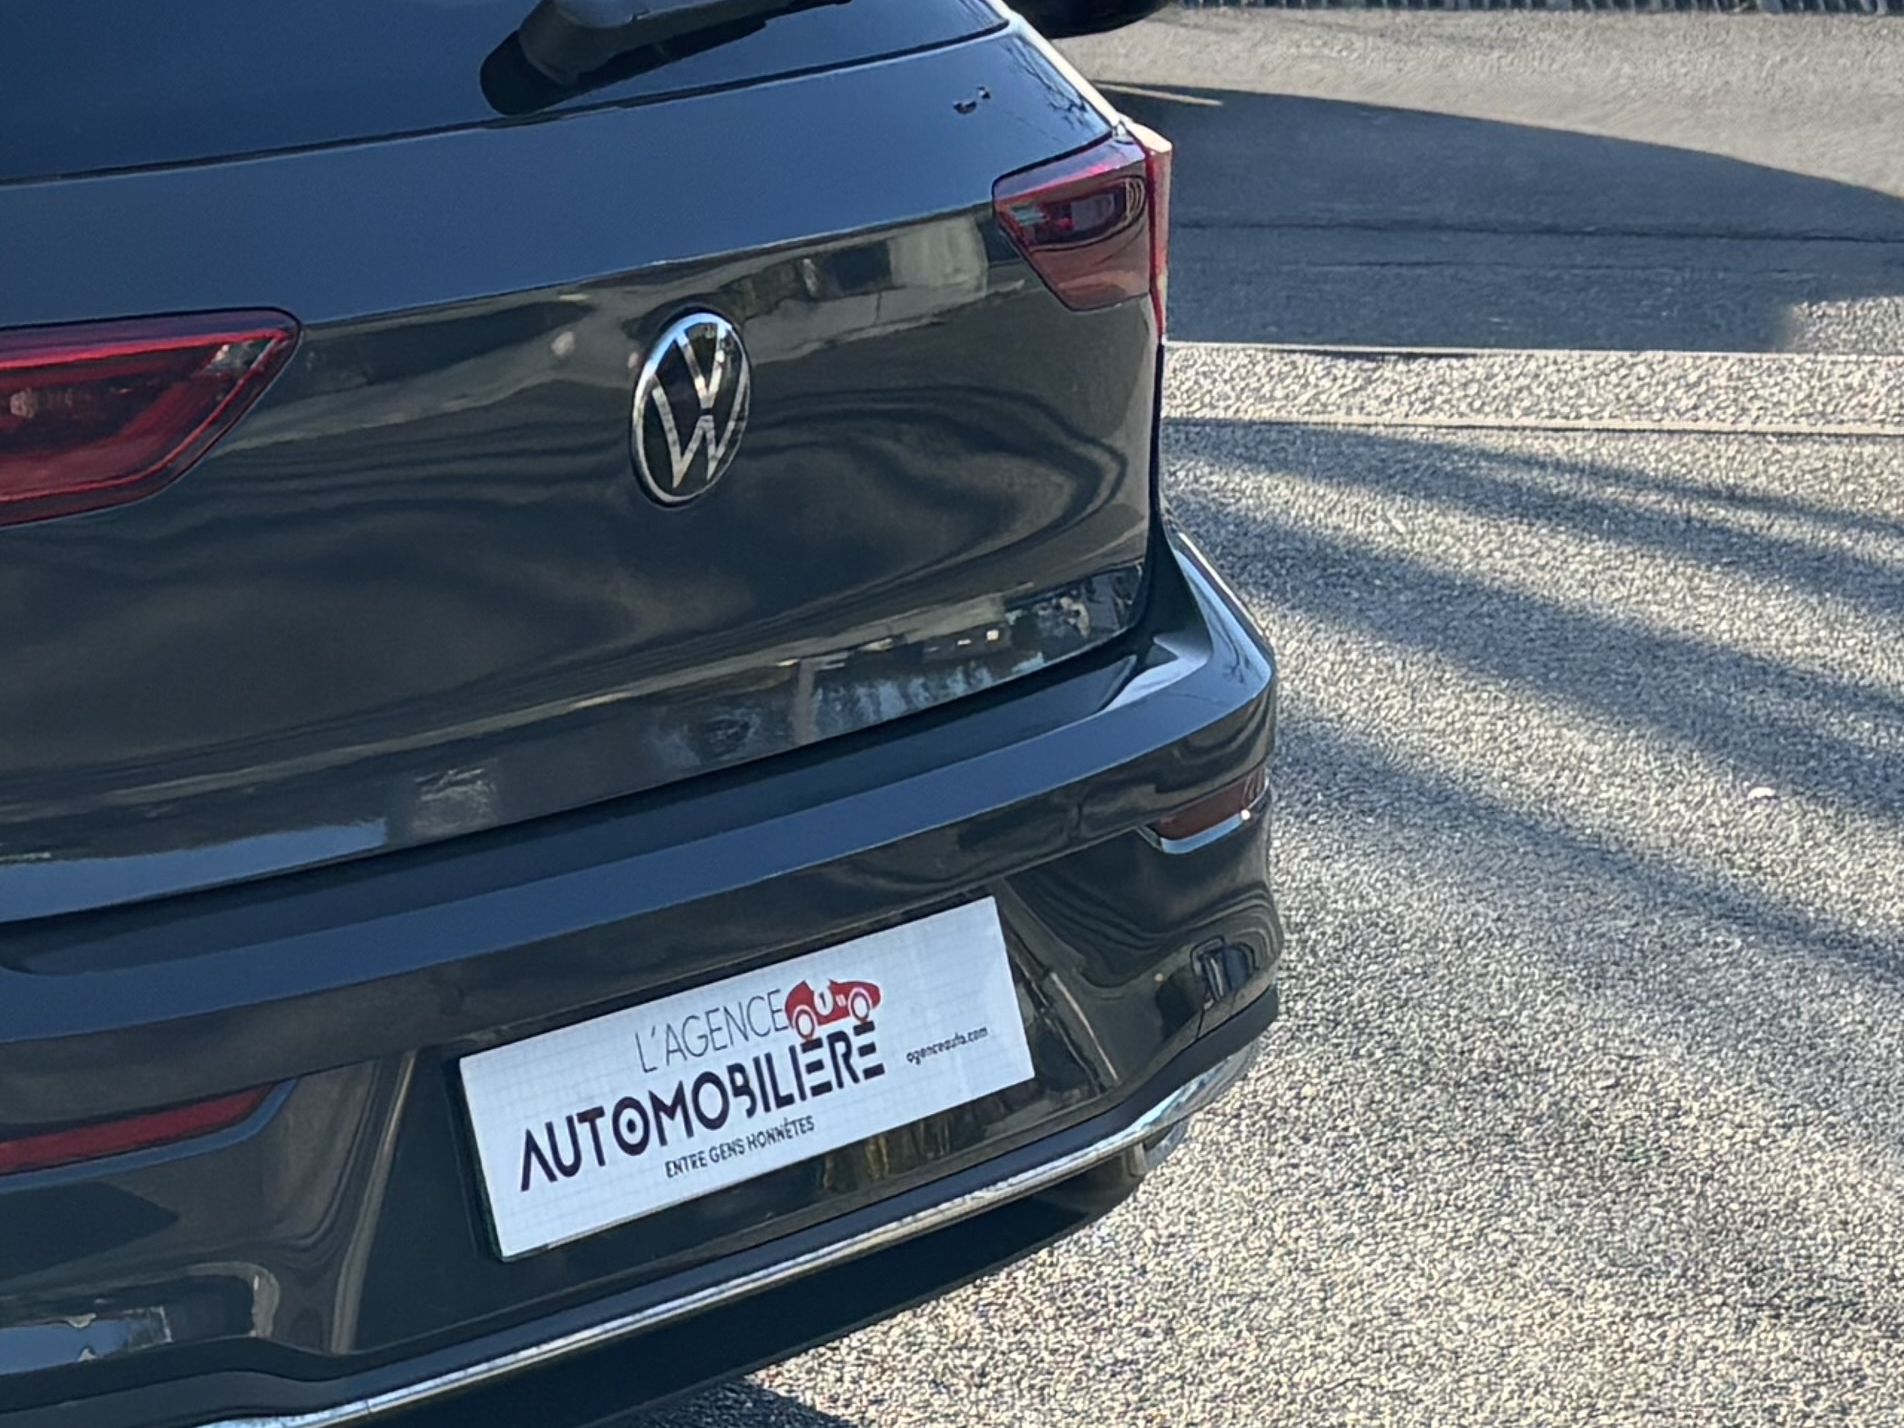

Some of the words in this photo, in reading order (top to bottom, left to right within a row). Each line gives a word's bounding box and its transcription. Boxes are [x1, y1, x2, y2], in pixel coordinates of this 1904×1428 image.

[634, 989, 790, 1074] L'AGENCE
[664, 1150, 708, 1178] ENTRE
[708, 1137, 745, 1163] GENS
